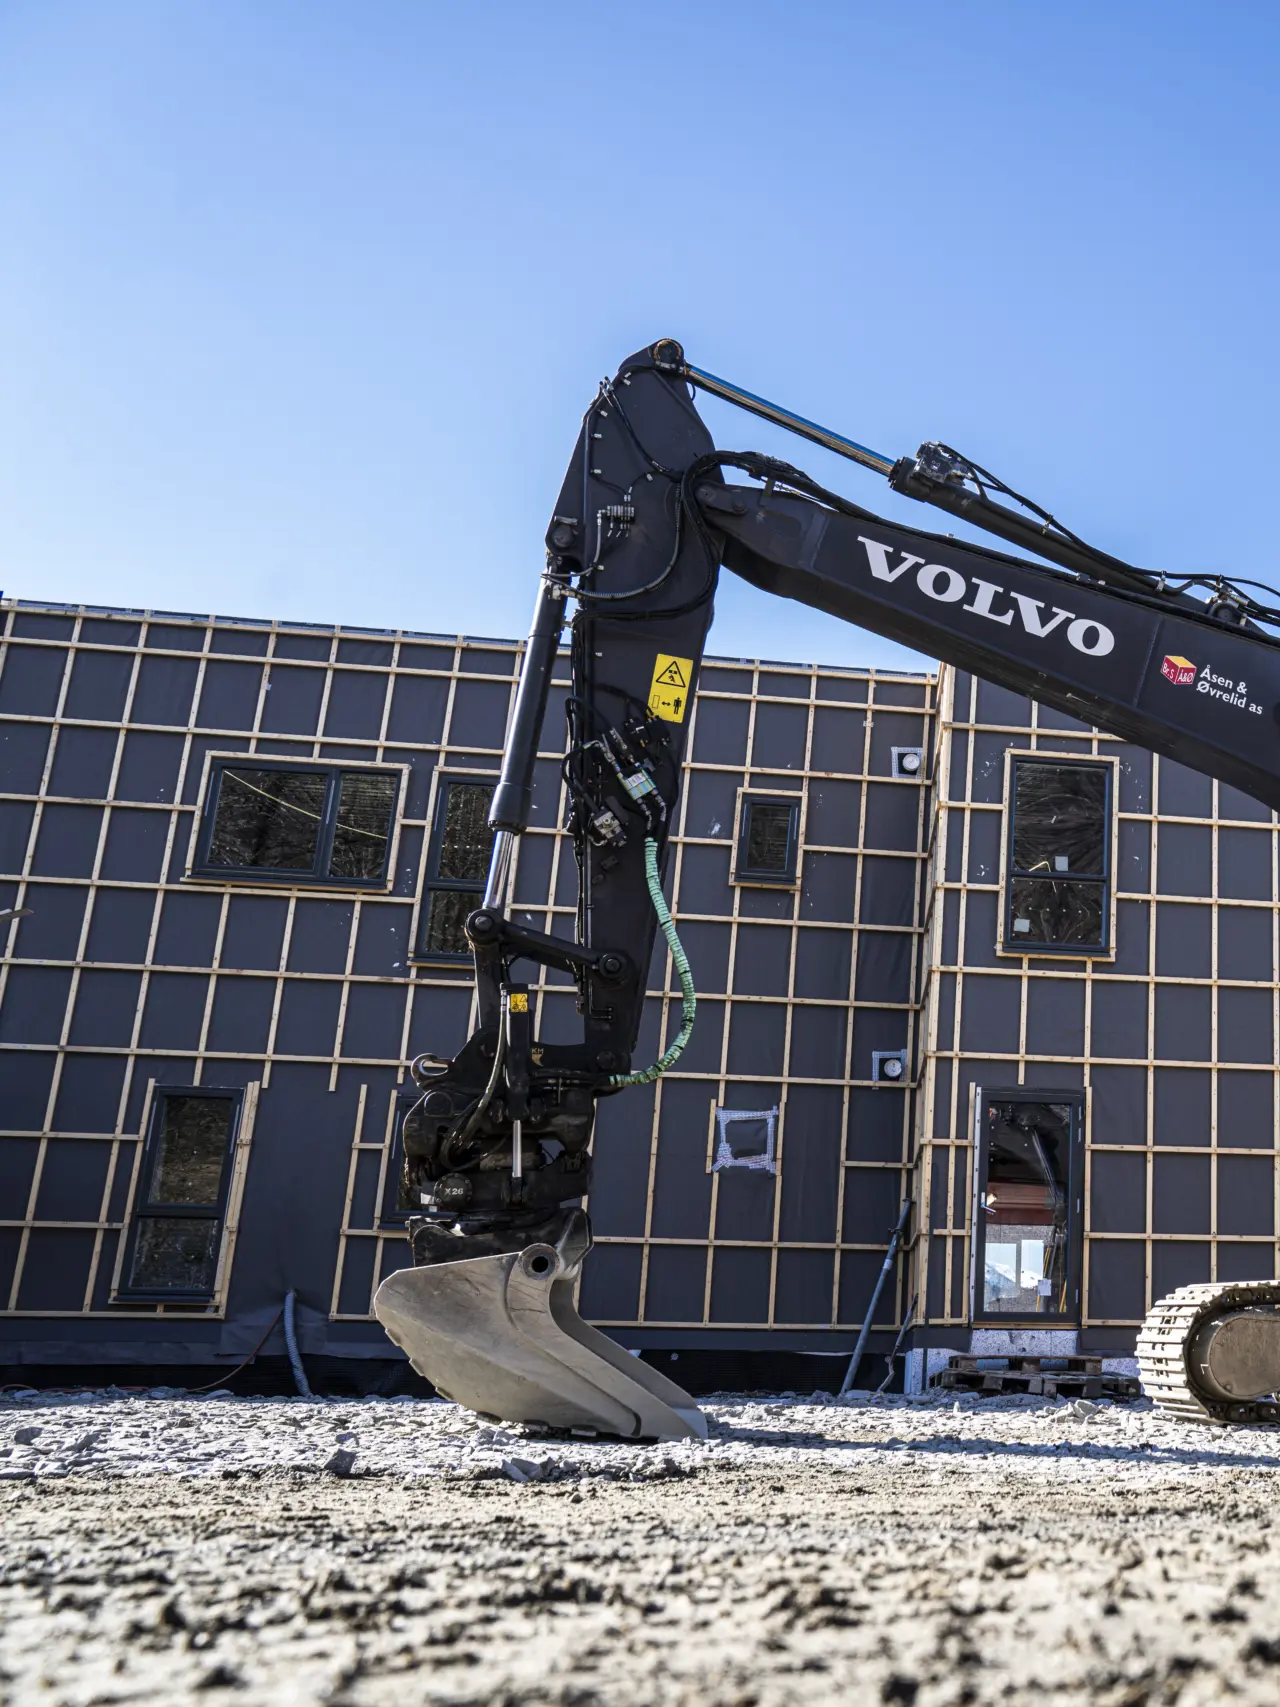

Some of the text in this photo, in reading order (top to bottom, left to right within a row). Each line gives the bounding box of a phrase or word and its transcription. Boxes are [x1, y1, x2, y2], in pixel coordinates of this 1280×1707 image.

[857, 536, 1115, 657] VOLVO
[1200, 664, 1248, 694] Åsen &
[1196, 680, 1263, 715] Øvrelid as
